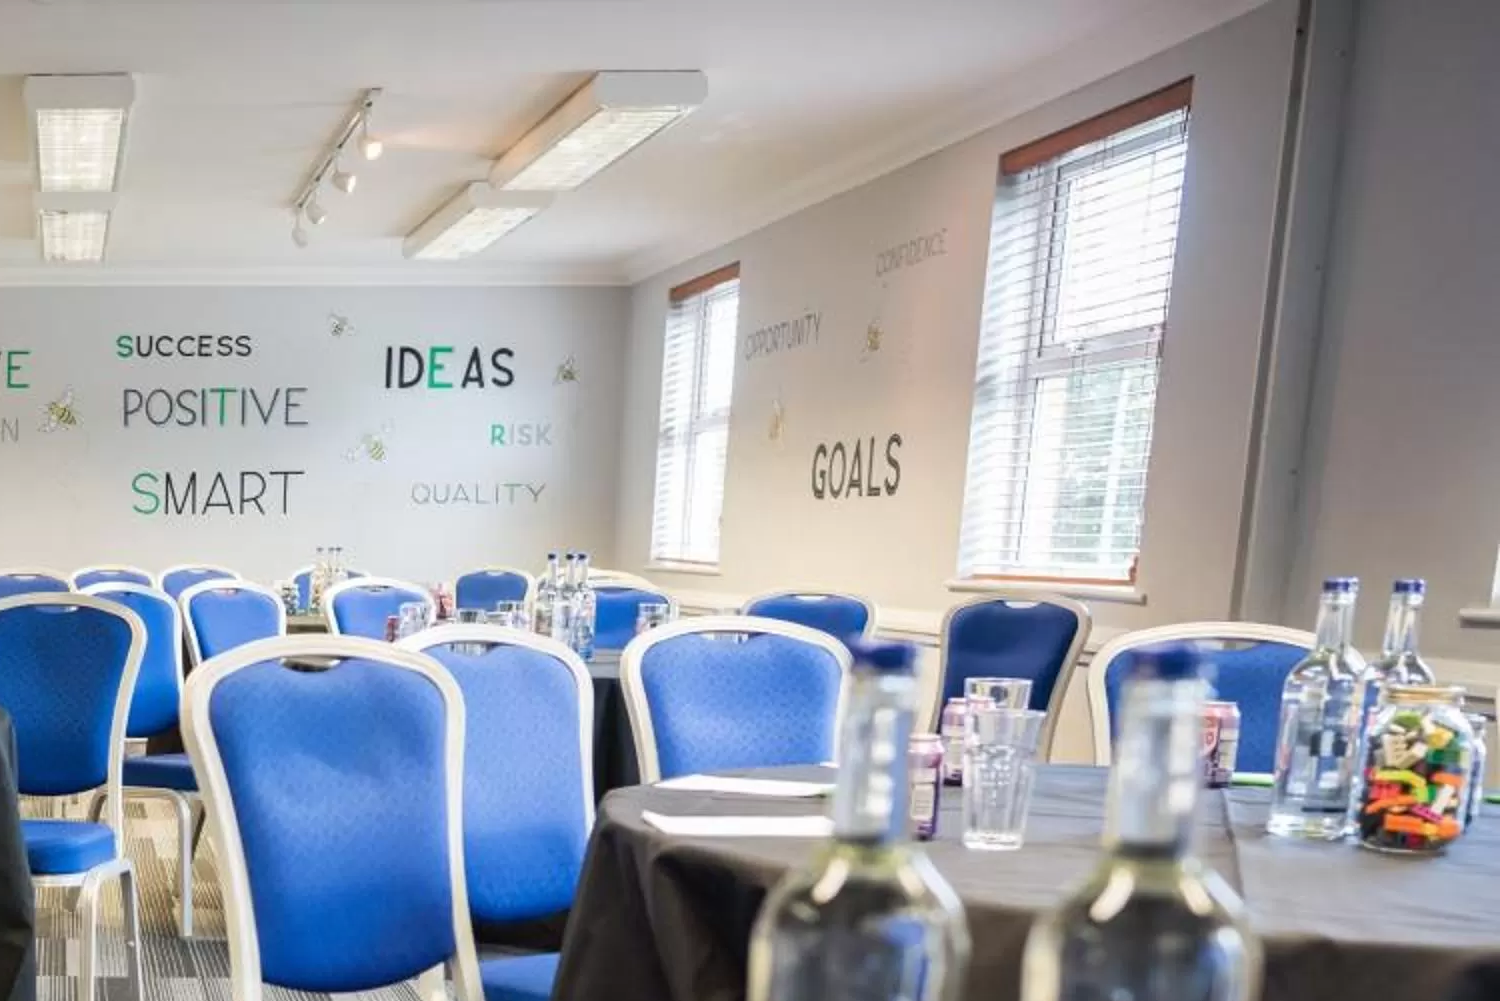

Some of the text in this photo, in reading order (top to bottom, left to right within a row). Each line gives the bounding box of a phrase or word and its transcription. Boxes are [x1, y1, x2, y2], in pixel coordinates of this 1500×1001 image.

[116, 335, 252, 359] SUCCESS
[746, 311, 822, 361] OPPORTUNITY
[384, 346, 516, 389] IDEAS
[123, 387, 308, 427] POSITIVE
[490, 423, 553, 447] RISK
[811, 433, 903, 500] GOALS
[131, 470, 304, 516] SMART
[410, 482, 547, 506] QUALITY
